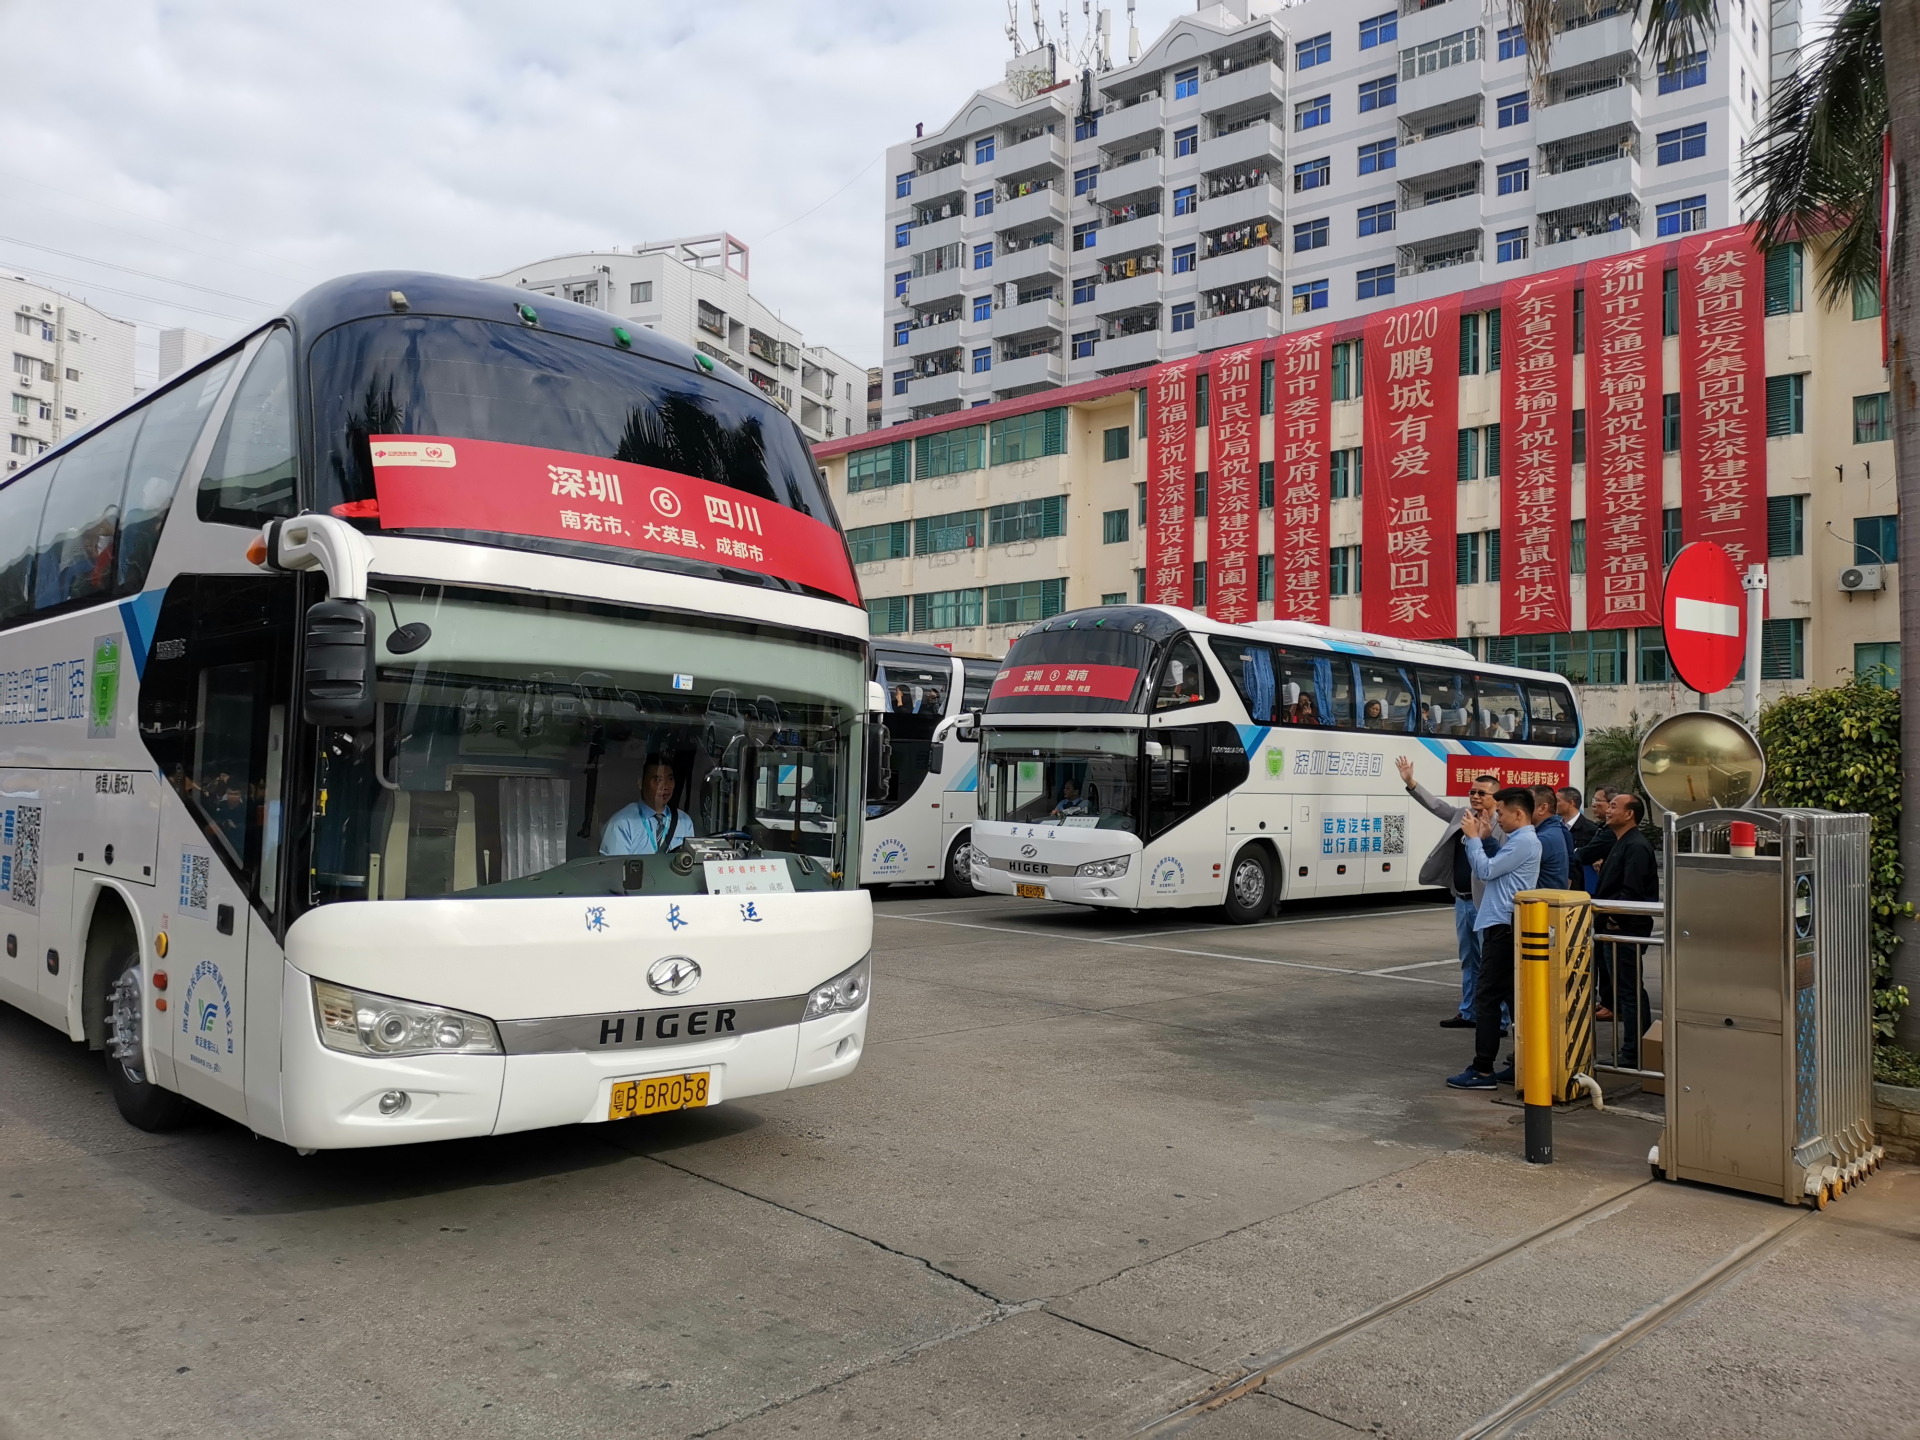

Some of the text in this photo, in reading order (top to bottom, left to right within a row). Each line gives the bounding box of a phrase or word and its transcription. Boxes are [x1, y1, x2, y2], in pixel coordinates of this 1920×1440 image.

[1383, 306, 1438, 349] 2020
[1514, 276, 1559, 622] 广东省交通运输厅祝来深建设者鼠年快乐
[1599, 254, 1649, 615] 深圳市交通运输局祝来深建设者幸福团圆
[547, 464, 623, 505] 深圳
[703, 494, 763, 536] 四川
[1154, 363, 1187, 605] 深圳福彩祝来深建设者新春
[1386, 345, 1434, 624] 鹏城有爱 温暖回家
[559, 509, 764, 562] 南充市、大英县、成都市
[1022, 670, 1044, 682] 深圳
[1065, 669, 1090, 682] 湖南
[1293, 750, 1384, 777] 深圳运发集团
[1322, 836, 1382, 854] 出行真需要
[1323, 817, 1382, 834] 运发汽车票
[1008, 861, 1049, 875] HIGER
[585, 901, 764, 933] 深长运
[599, 1008, 737, 1045] HIGER
